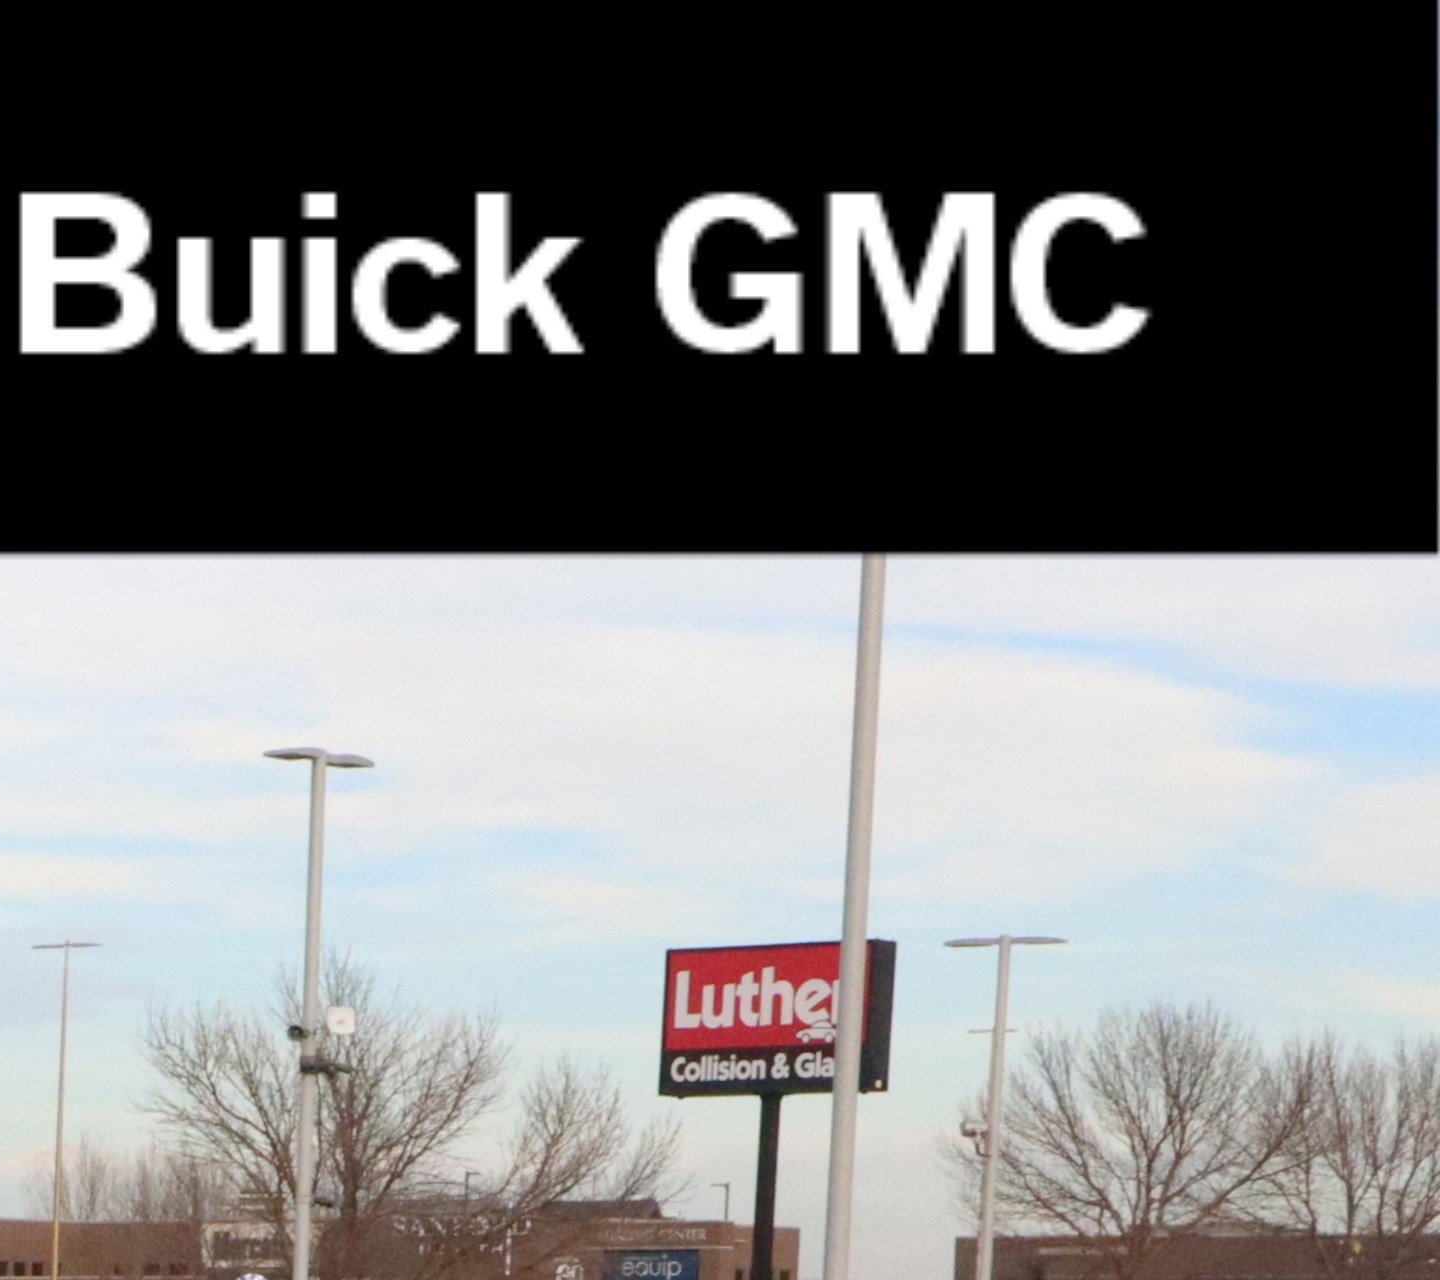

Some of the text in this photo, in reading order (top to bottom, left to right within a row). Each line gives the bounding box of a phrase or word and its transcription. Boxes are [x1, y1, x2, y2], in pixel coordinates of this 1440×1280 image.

[670, 1051, 834, 1083] Collision & Gla
